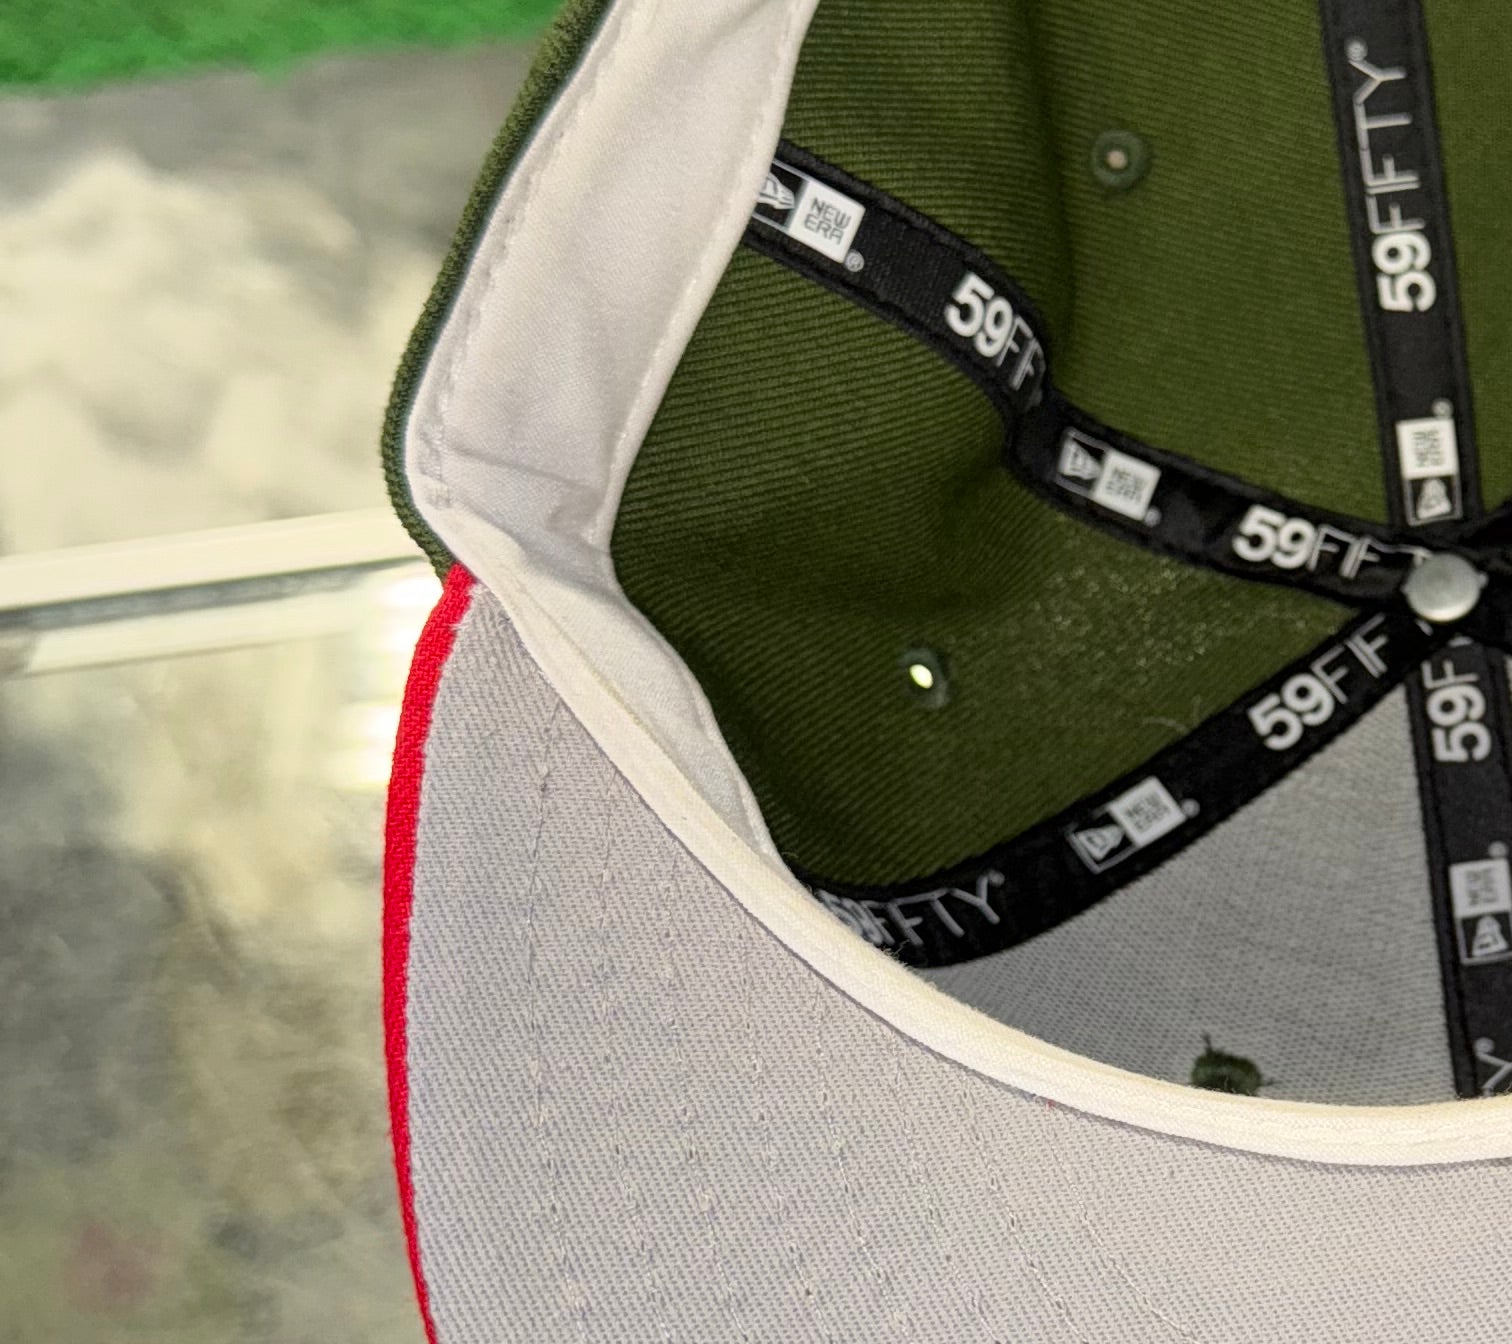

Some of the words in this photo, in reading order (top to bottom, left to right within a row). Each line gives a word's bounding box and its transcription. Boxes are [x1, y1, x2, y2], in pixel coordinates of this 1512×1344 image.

[804, 213, 844, 245] ERA
[811, 197, 852, 230] NEW
[1347, 56, 1437, 313] 59FIFTY
[944, 271, 1046, 392] 59FIF
[1247, 611, 1389, 751] 59FIF
